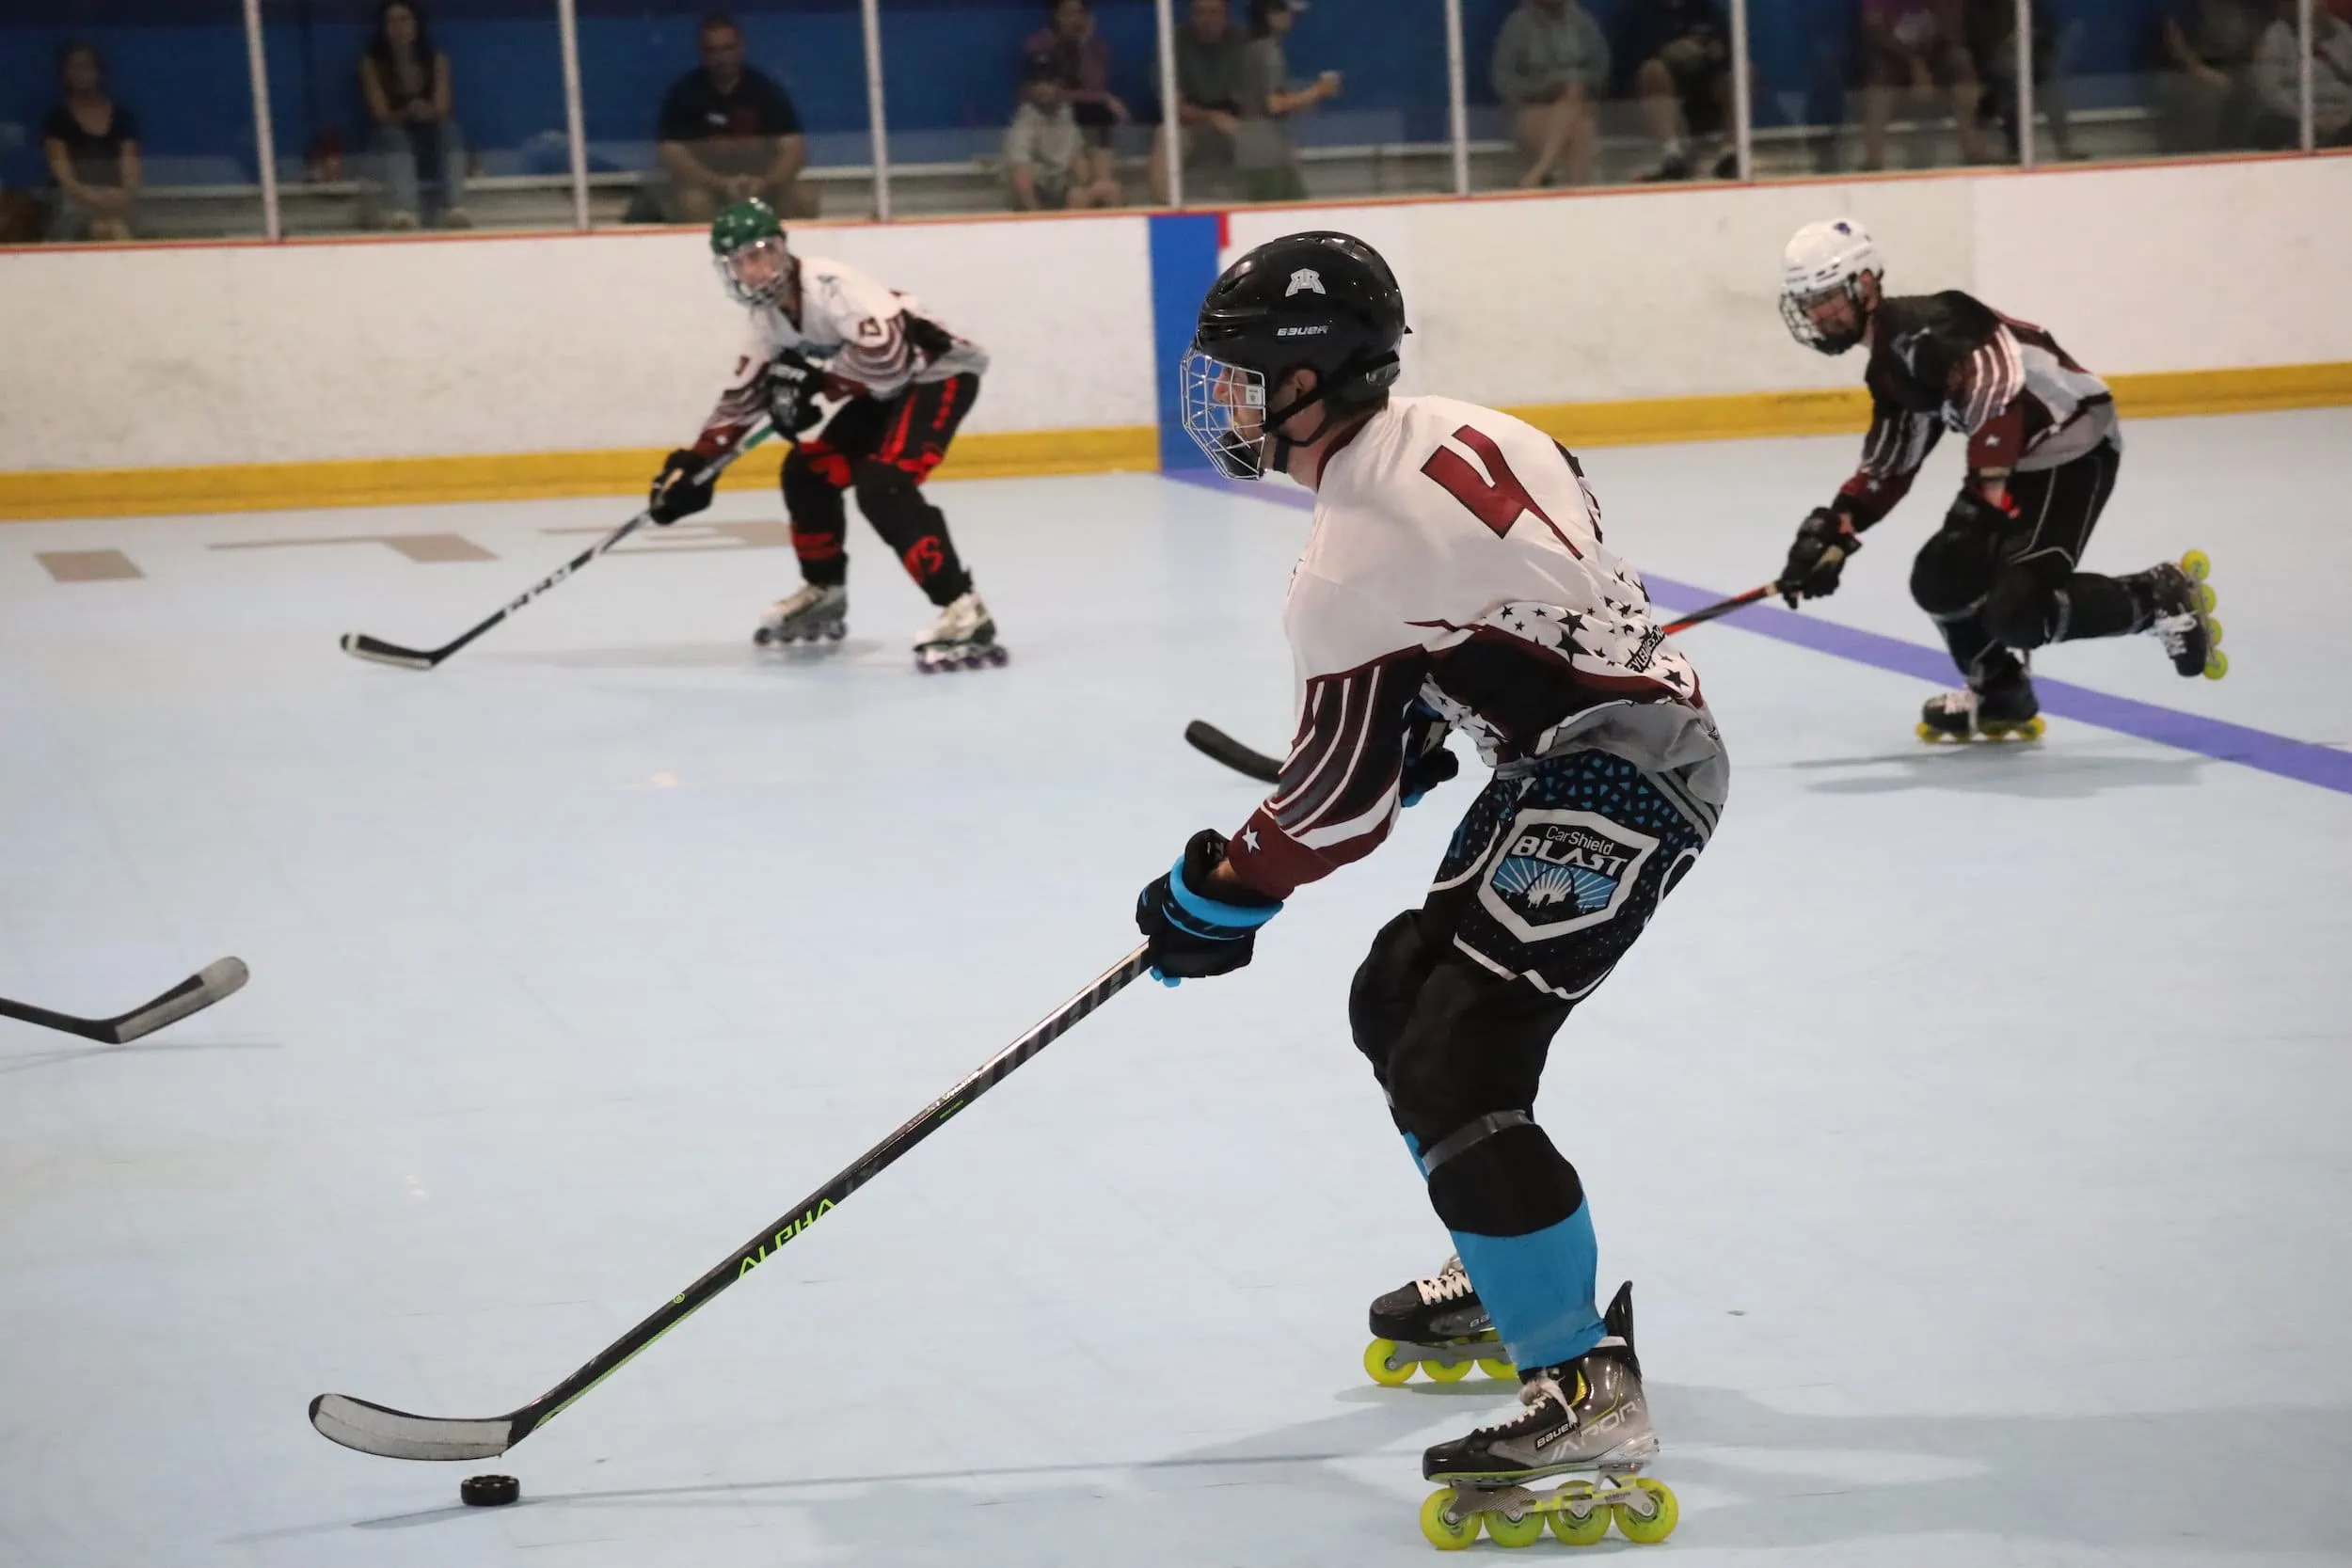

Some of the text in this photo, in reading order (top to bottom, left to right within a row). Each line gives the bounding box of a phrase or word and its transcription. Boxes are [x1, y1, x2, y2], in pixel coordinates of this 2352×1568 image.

[1511, 835, 1629, 877] BLAST
[1546, 826, 1614, 855] CarShield
[737, 1198, 836, 1280] ALPHA
